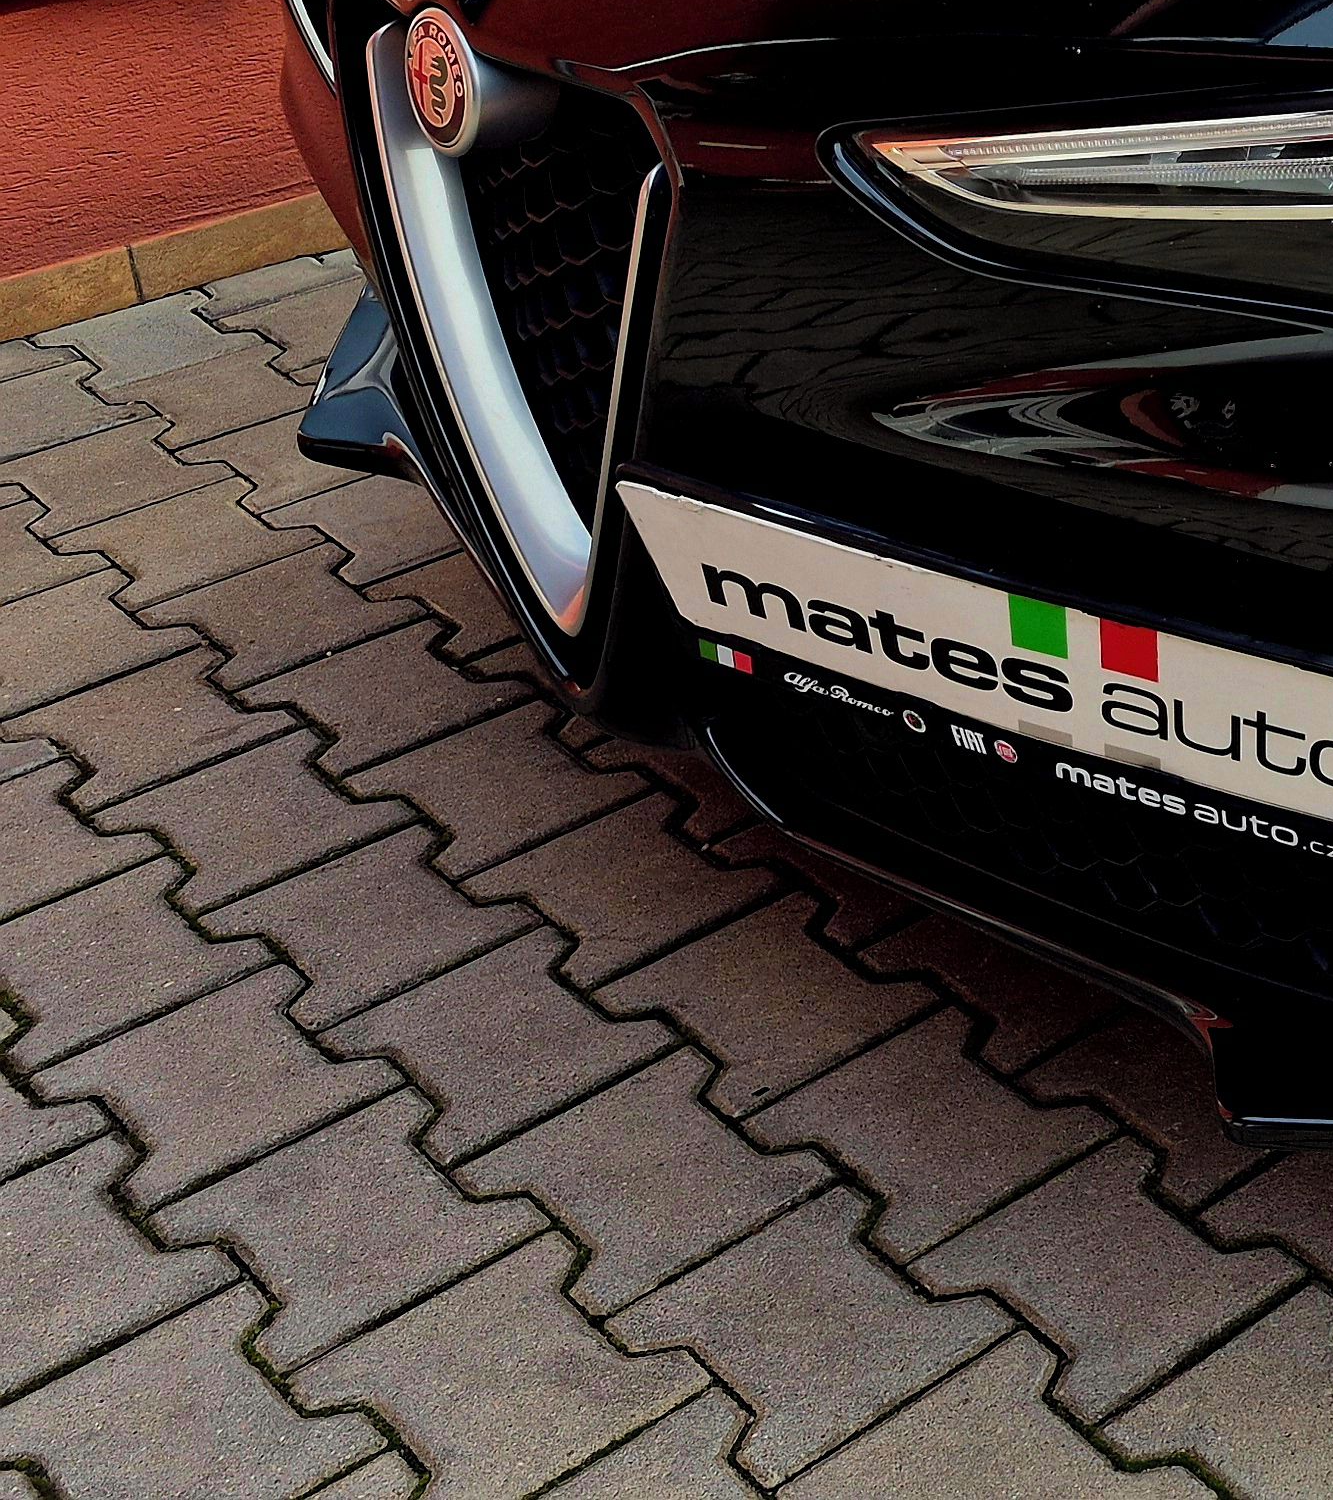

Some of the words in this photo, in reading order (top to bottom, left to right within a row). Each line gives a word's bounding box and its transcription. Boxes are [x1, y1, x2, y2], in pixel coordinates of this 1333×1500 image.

[428, 24, 464, 98] ROMEO
[700, 561, 1075, 712] mates
[783, 671, 829, 693] Alfa
[829, 685, 894, 717] Romeo
[951, 724, 988, 754] FIAT
